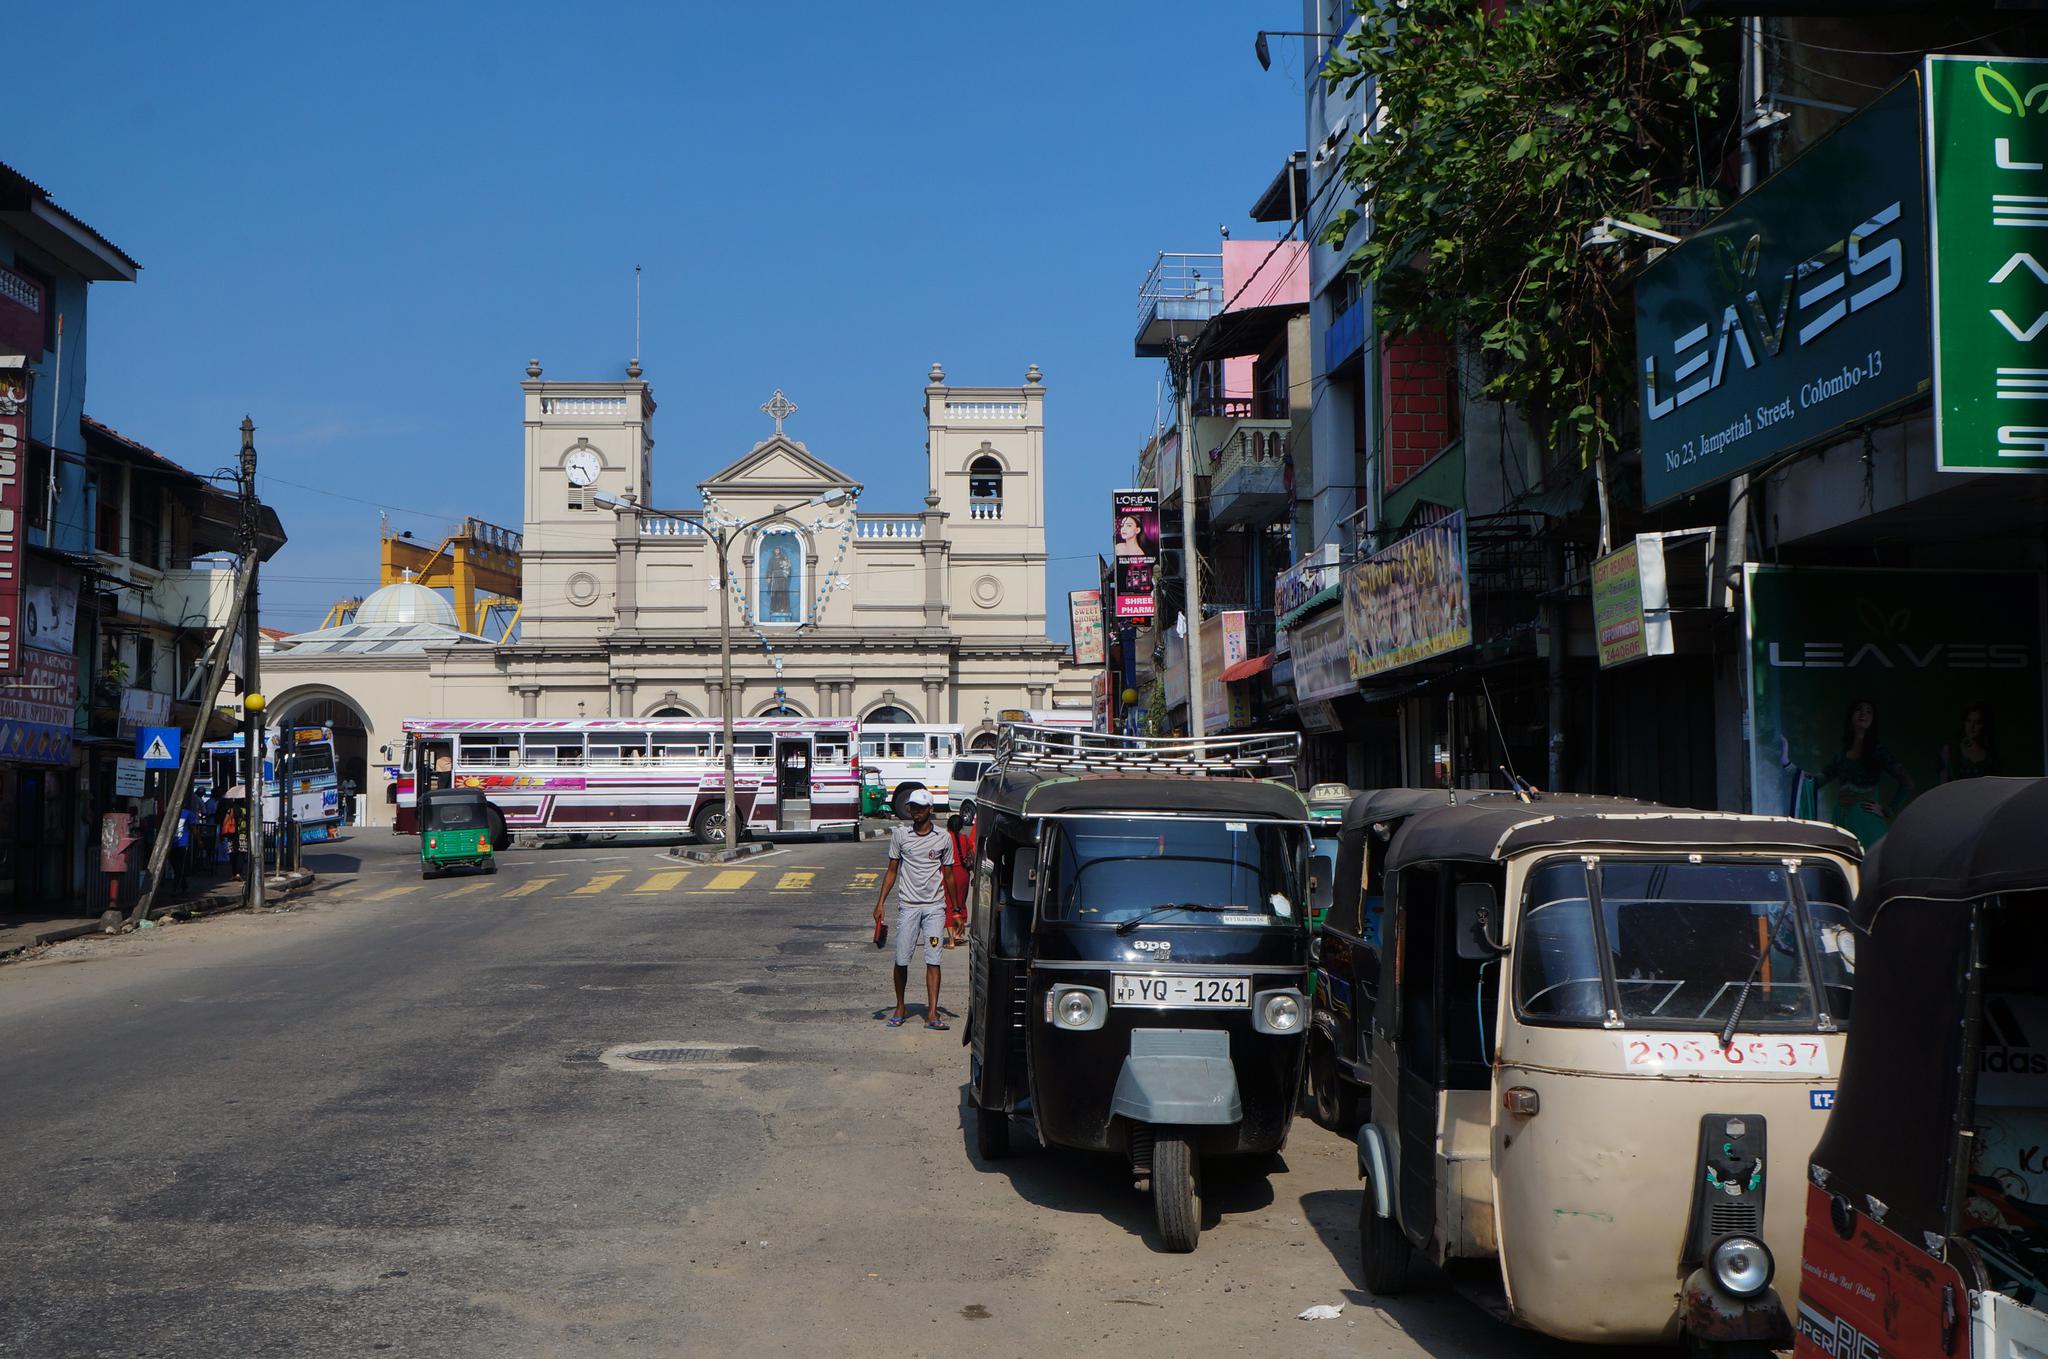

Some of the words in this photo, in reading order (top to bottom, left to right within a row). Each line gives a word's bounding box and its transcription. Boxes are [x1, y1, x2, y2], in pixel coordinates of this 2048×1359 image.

[1988, 138, 2048, 458] LEAVES
[1647, 200, 1903, 421] LEAVES
[1666, 451, 1680, 473] No
[1682, 445, 1697, 466] 23,
[1700, 418, 1752, 457] Jampettah
[1757, 398, 1795, 432] Street,
[1801, 351, 1883, 410] Colombo-13
[1116, 495, 1157, 505] L'ORÉAL
[1074, 607, 1098, 615] SWEET
[1125, 597, 1153, 605] SHREE
[1602, 620, 1639, 642] APPOINTMENTS
[1605, 641, 1640, 662] 2440606
[1769, 642, 2029, 668] LEAVES
[31, 667, 74, 706] OFFICE
[1317, 786, 1344, 796] TAXI
[1133, 940, 1171, 951] ape
[1117, 988, 1135, 1000] WP
[1139, 979, 1168, 1001] YQ
[1193, 981, 1247, 1002] 1261
[1979, 1046, 2048, 1074] idas
